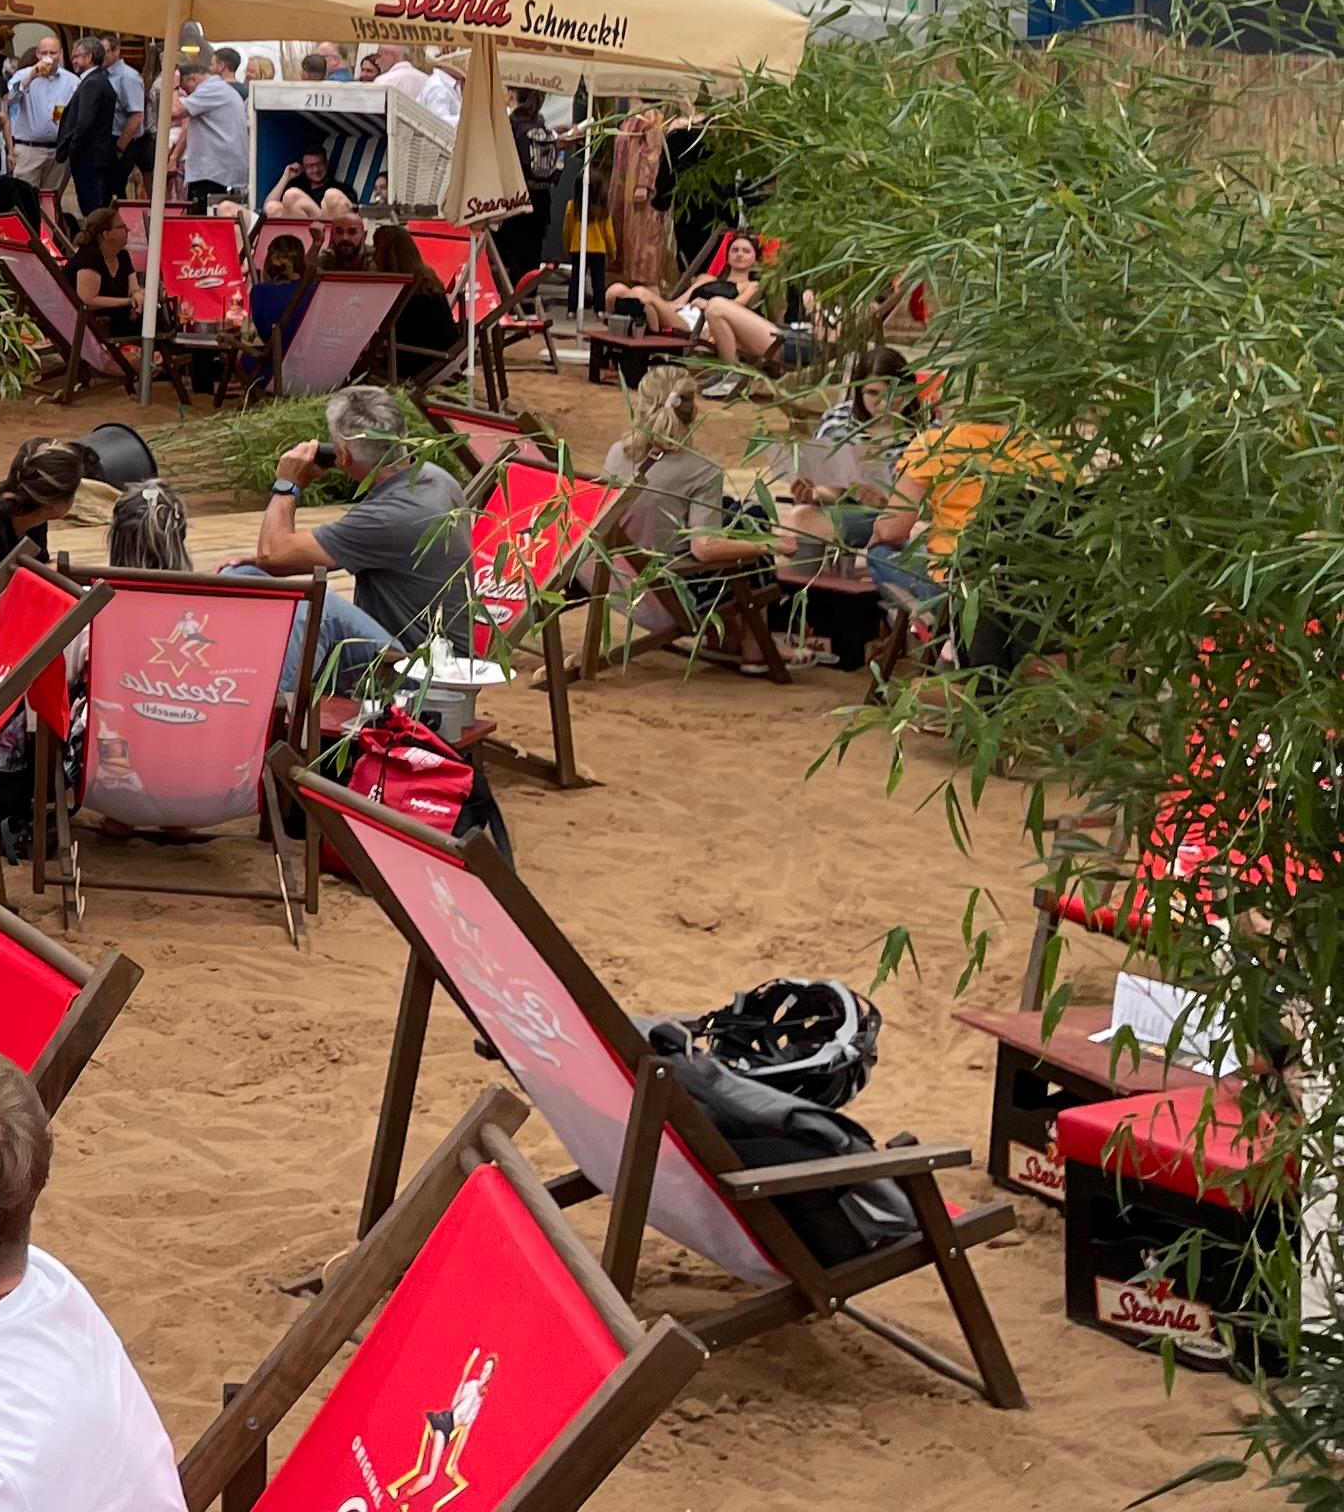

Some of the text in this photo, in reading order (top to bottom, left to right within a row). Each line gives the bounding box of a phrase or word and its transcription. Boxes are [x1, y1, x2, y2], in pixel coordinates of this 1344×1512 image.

[519, 0, 629, 49] Schmeckt!
[305, 94, 333, 108] 2113
[1112, 1291, 1201, 1332] Sternla
[351, 1434, 384, 1510] ORIGINAL
